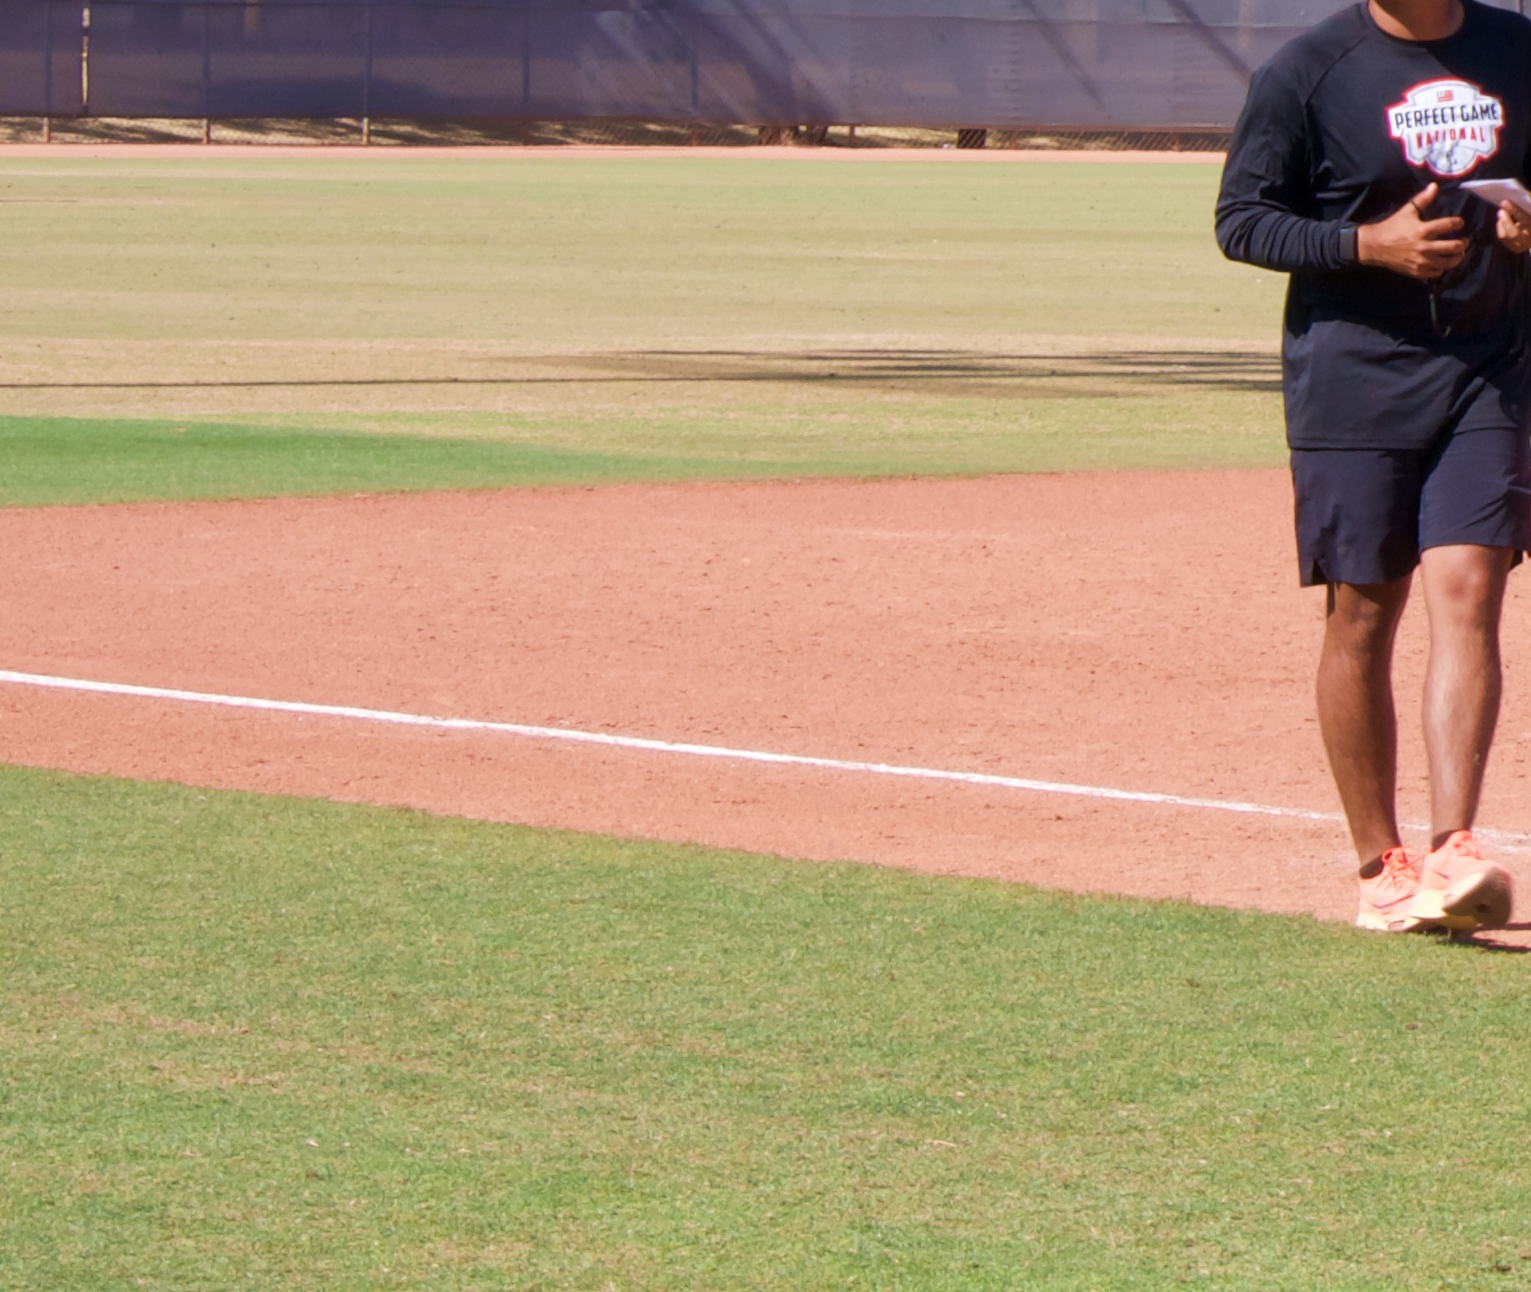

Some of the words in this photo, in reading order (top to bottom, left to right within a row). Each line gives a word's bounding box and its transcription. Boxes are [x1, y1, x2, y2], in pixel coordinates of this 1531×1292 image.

[1394, 107, 1457, 129] PERFECT
[1460, 103, 1498, 123] GAME
[1416, 126, 1486, 150] NATIONAL
